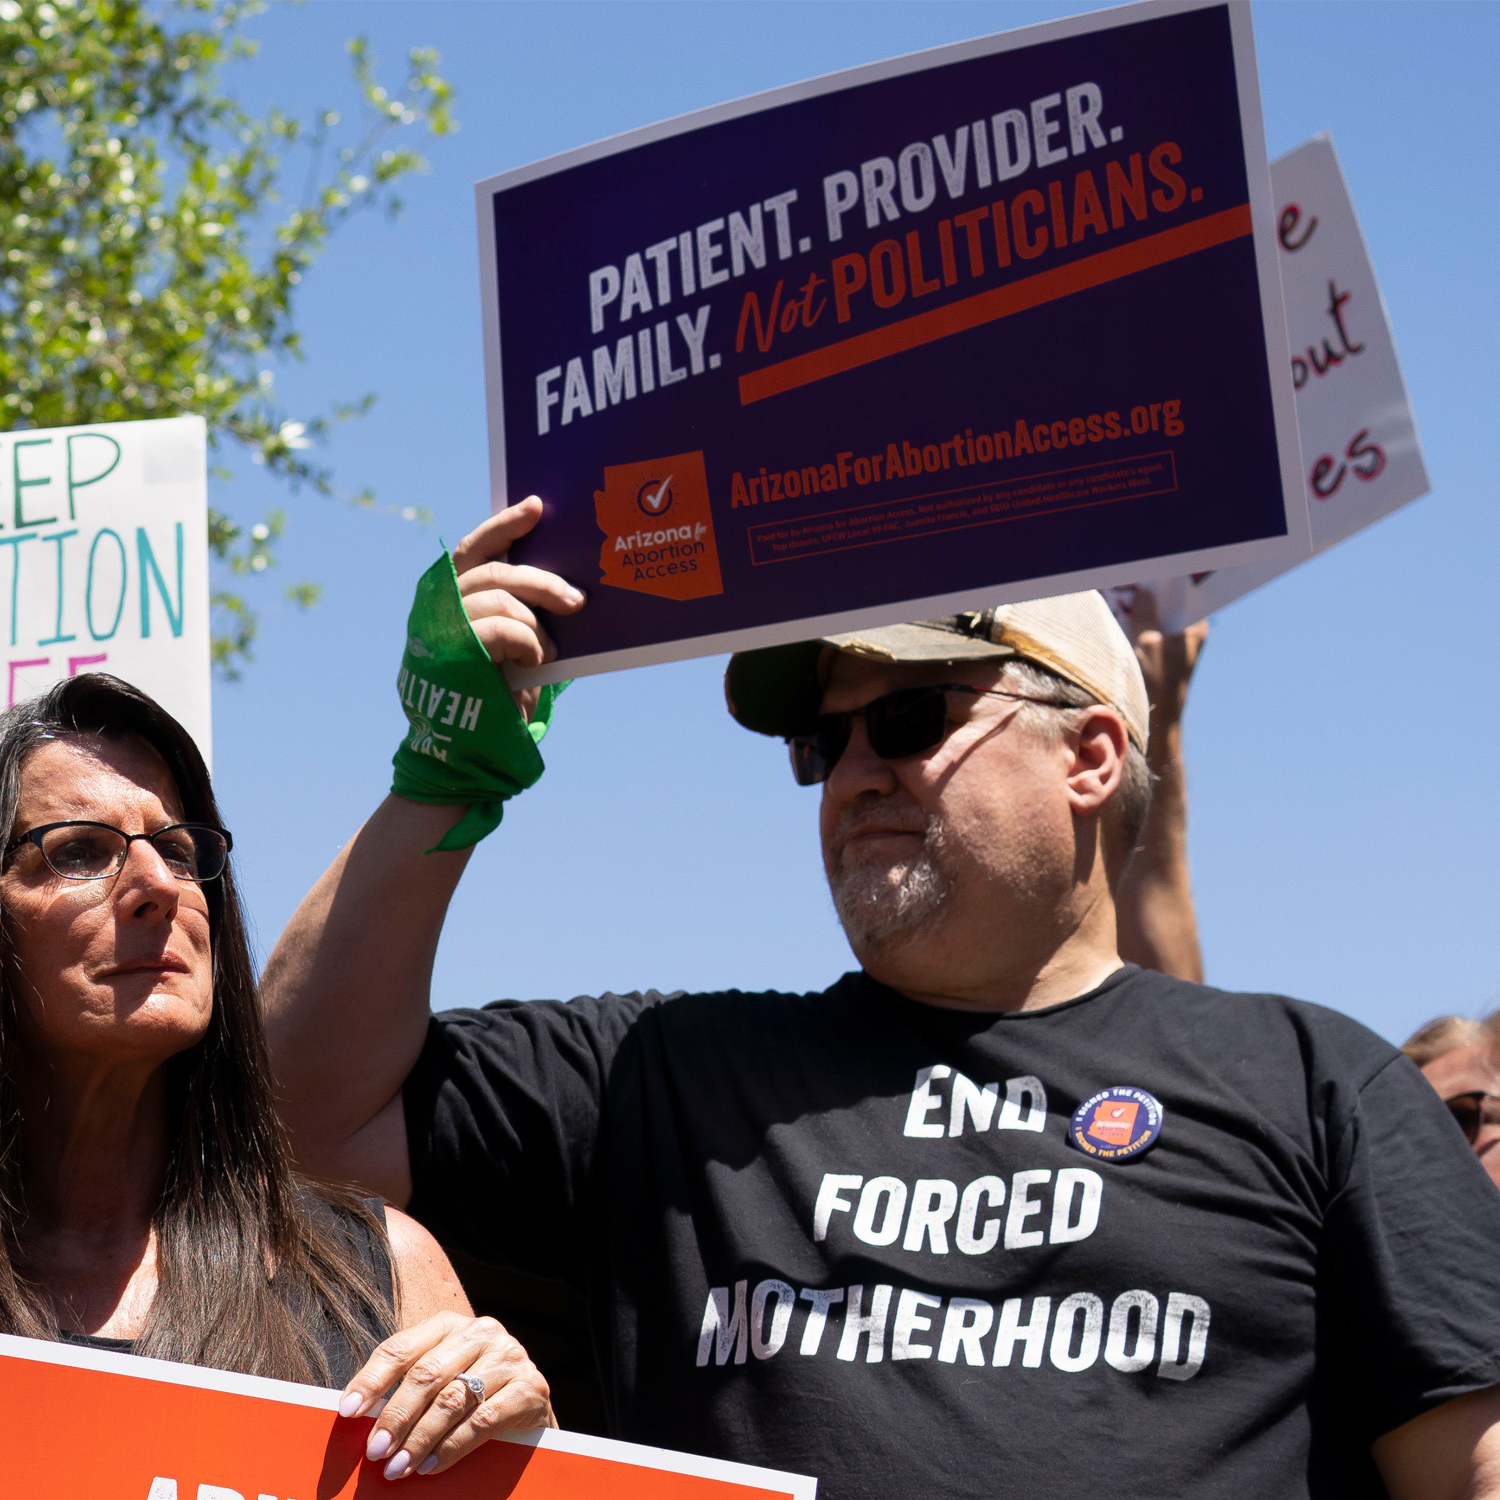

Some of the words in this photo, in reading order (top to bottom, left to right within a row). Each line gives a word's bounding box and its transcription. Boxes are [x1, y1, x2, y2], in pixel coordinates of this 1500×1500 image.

[588, 189, 813, 334] PATIENT.
[823, 81, 1125, 242] PROVIDER.
[535, 303, 722, 436] FAMILY.
[735, 269, 828, 354] Not
[833, 141, 1205, 324] POLITICIANS.
[731, 400, 1185, 509] ArizonaForAbortionAccess.org
[614, 525, 692, 552] Arizona
[622, 541, 706, 568] Abortion
[634, 558, 698, 582] Access
[903, 1064, 1048, 1139] END
[1078, 1091, 1110, 1117] SIGNED
[1112, 1088, 1133, 1097] THE
[1132, 1090, 1158, 1126] PETITION
[1098, 1149, 1116, 1158] THE
[1116, 1129, 1152, 1156] PETITION
[814, 1167, 1104, 1255] FORCED
[696, 1279, 1211, 1380] MOTHERHOOD
